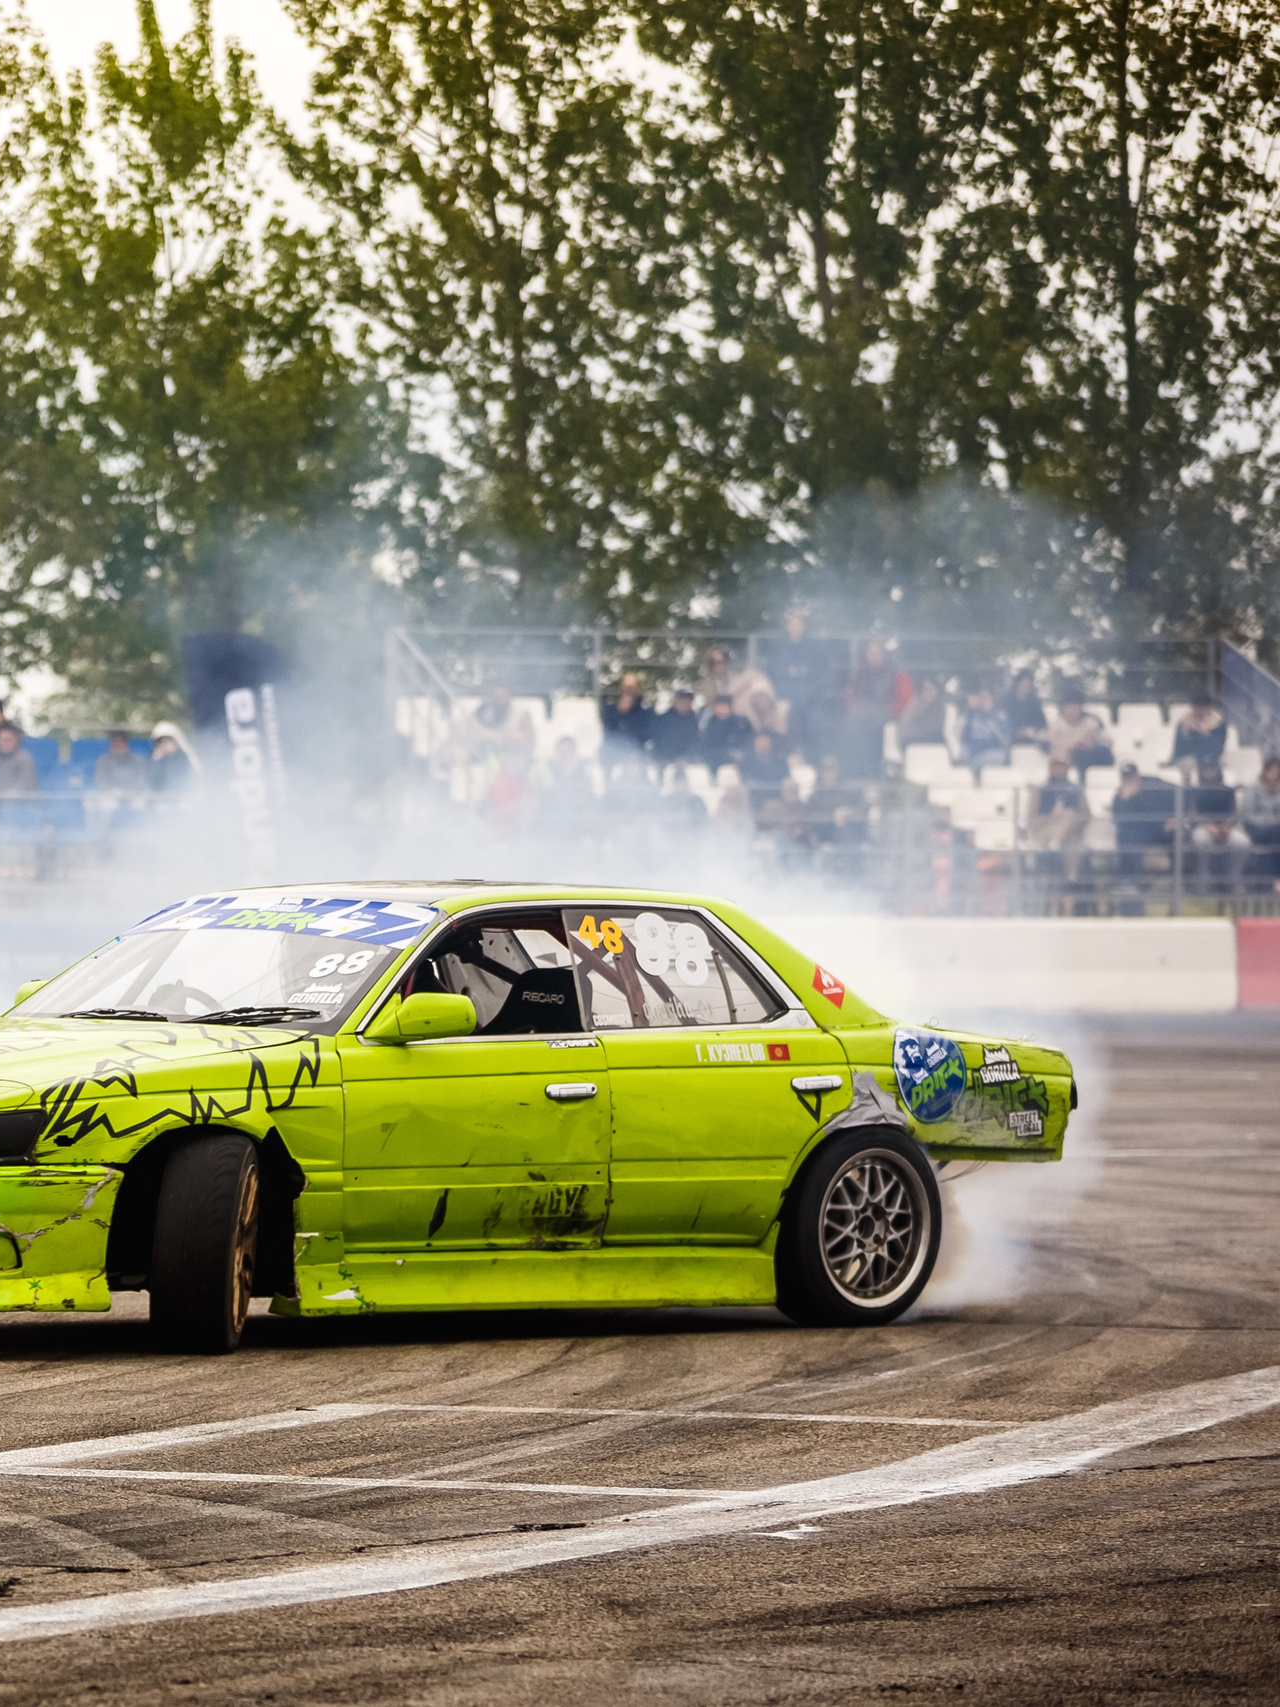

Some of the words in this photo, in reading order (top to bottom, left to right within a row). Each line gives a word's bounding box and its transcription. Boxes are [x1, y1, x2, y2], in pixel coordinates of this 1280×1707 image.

[578, 915, 624, 954] 48
[634, 912, 710, 987] 88
[309, 950, 375, 978] 88
[287, 992, 345, 1005] GORILLA
[522, 991, 565, 1005] RECARO
[695, 1044, 707, 1062] Г.
[707, 1044, 766, 1063] КУЗНЕЦОВ
[980, 1062, 1021, 1084] GORILLA
[1012, 1112, 1037, 1126] STREET
